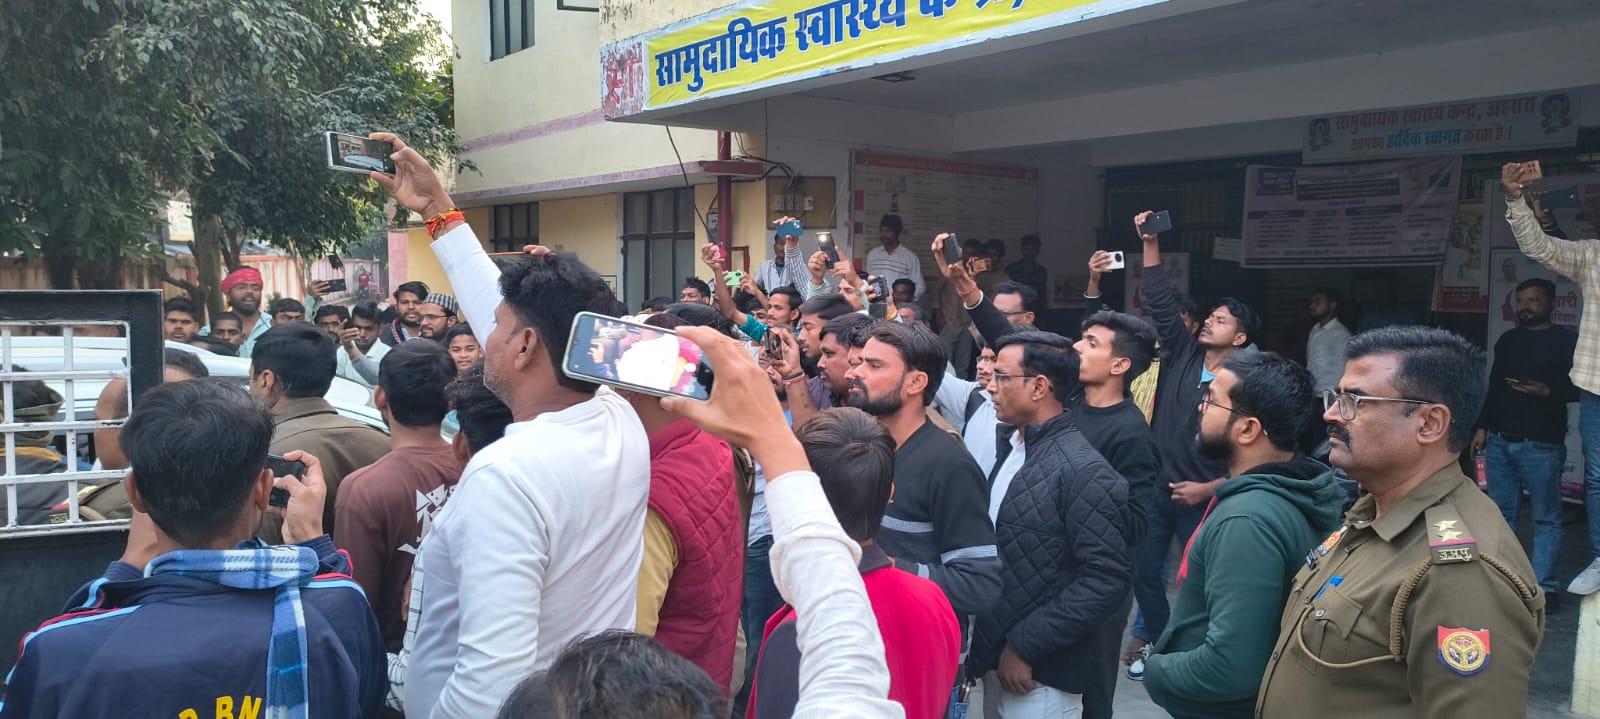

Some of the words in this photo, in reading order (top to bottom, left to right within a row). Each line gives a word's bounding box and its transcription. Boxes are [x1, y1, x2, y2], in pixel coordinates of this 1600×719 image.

[654, 16, 788, 93] सामुदायिक
[794, 0, 907, 51] स्वास्थ्य
[1387, 128, 1422, 149] हार्दिक
[216, 695, 262, 719] BN
